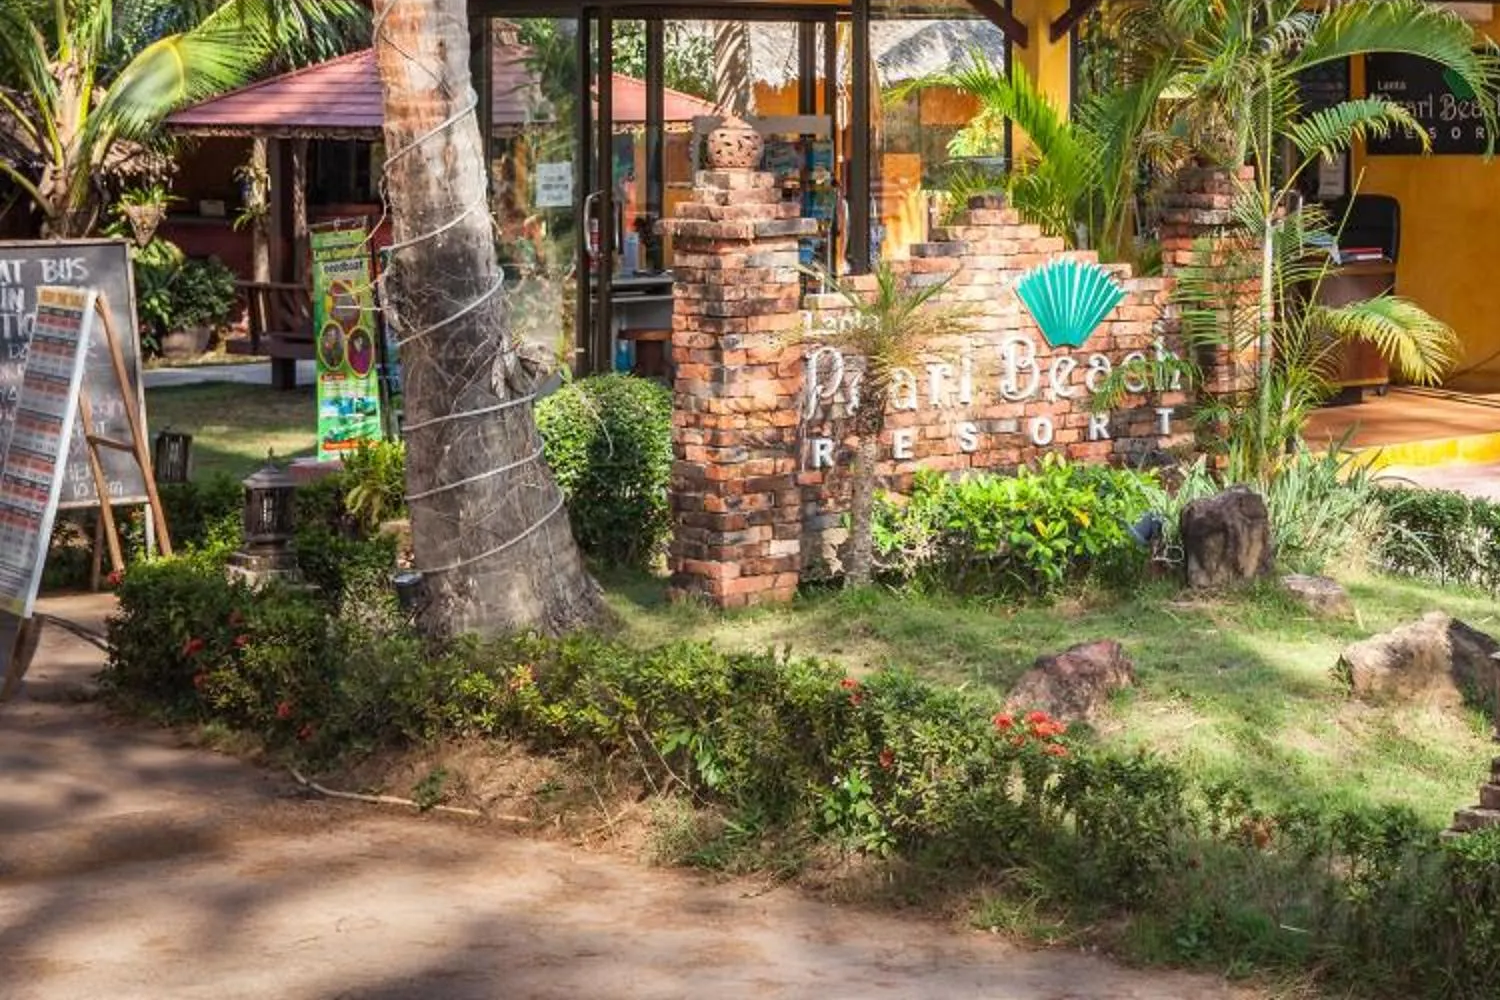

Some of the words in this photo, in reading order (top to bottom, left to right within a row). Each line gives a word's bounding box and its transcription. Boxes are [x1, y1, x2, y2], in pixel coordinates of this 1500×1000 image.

[1376, 90, 1433, 119] arl
[40, 256, 90, 283] BUS
[812, 408, 1175, 468] RESORT
